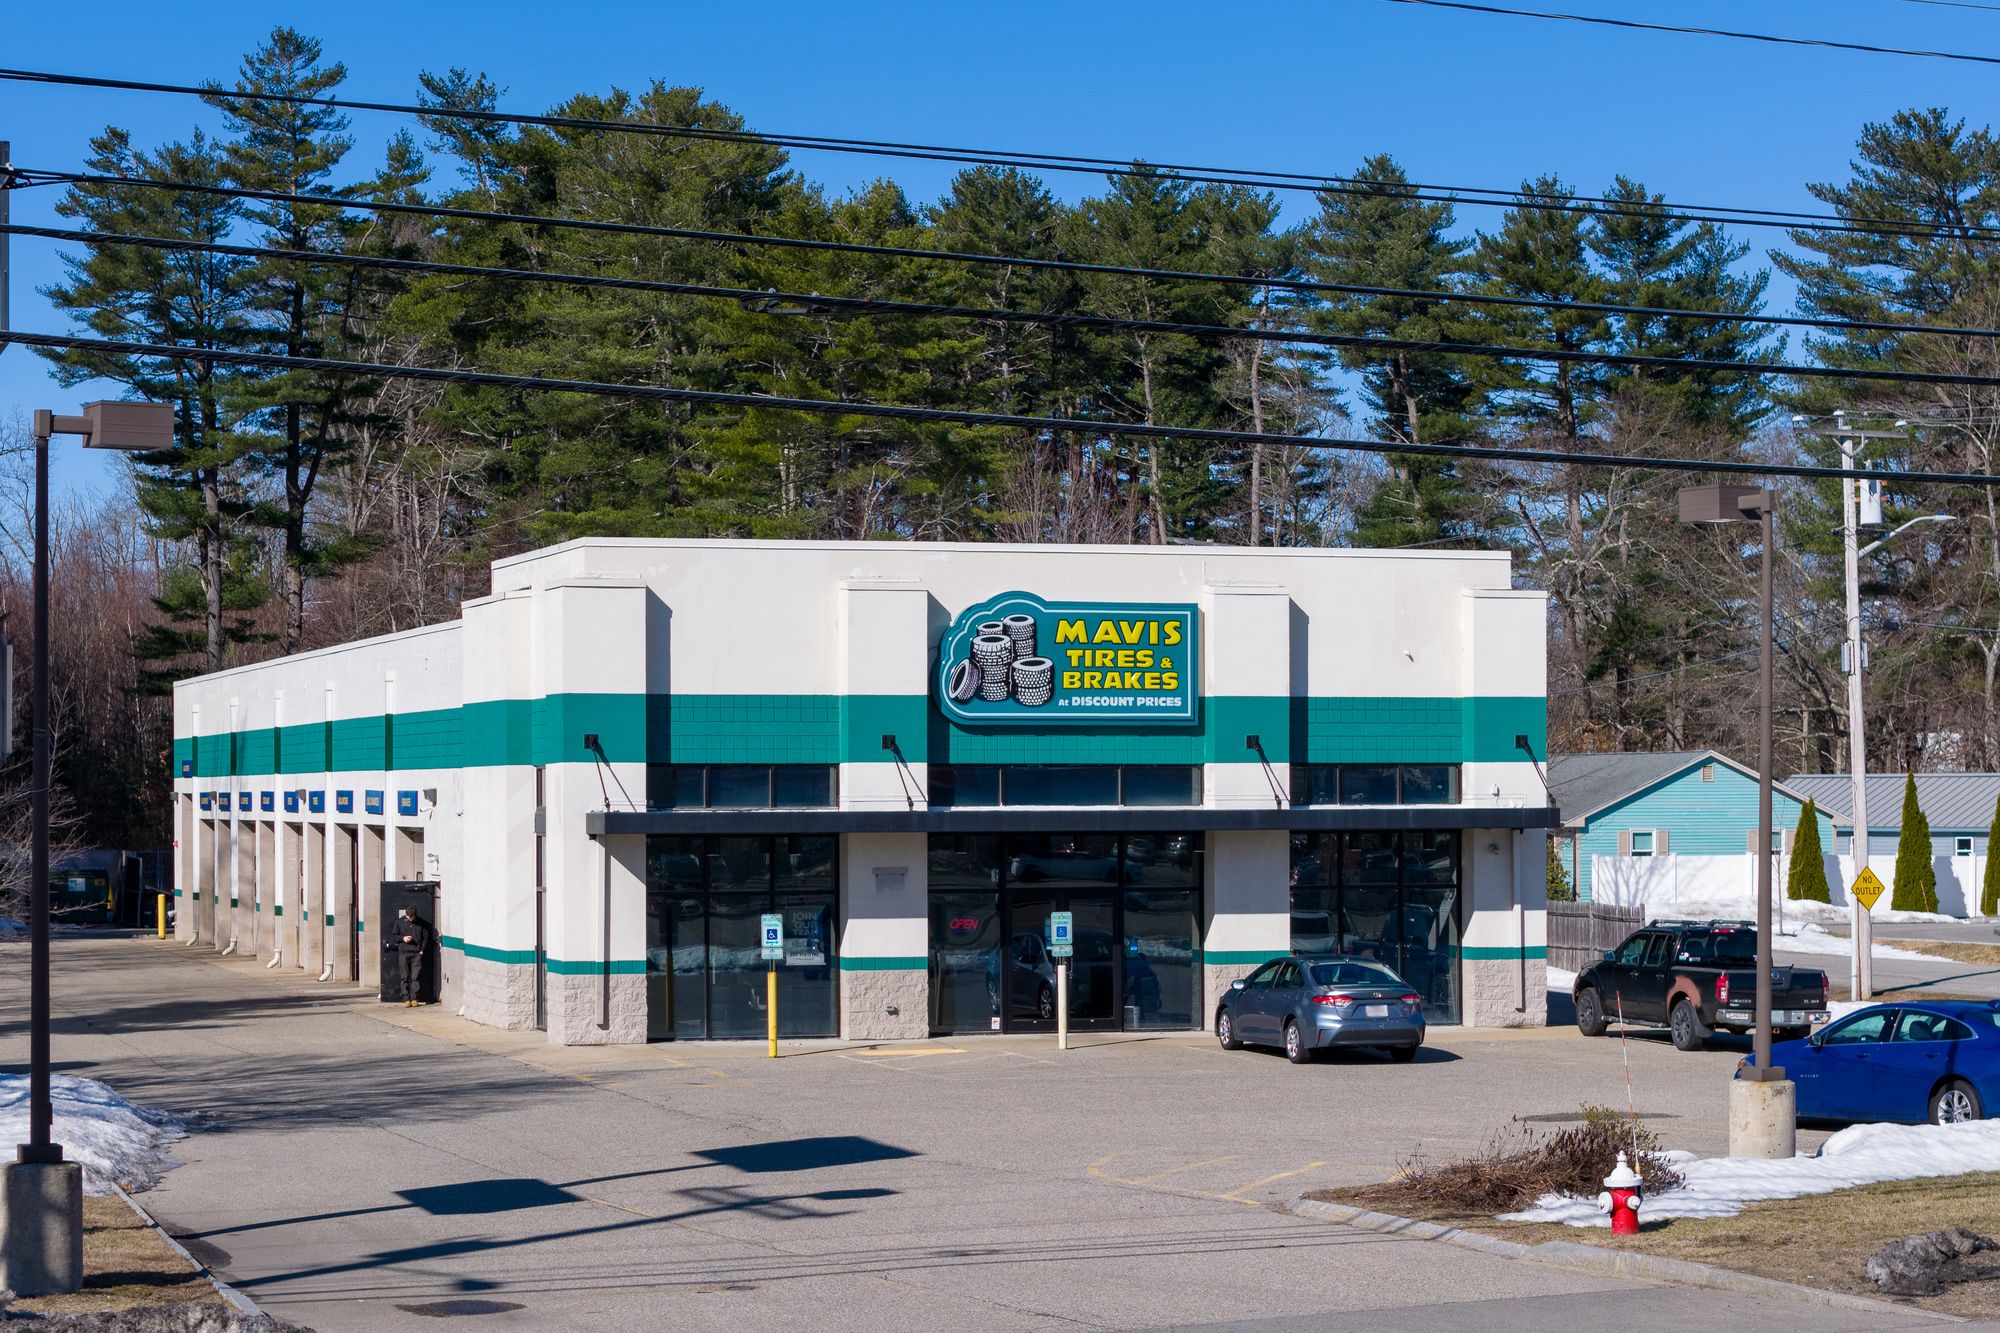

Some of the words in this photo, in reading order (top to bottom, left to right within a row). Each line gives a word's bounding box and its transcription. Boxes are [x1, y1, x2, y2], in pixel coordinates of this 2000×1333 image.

[1055, 619, 1182, 645] MAVIS
[1066, 649, 1154, 668] TIRES
[1160, 657, 1173, 668] &
[1062, 671, 1179, 690] BRAKES
[1071, 696, 1134, 706] DISCOUNT
[1136, 697, 1182, 706] PRICES
[1862, 876, 1873, 884] NO
[1855, 887, 1881, 895] OUTLET
[793, 911, 817, 921] JOIN
[950, 918, 977, 929] OPEN
